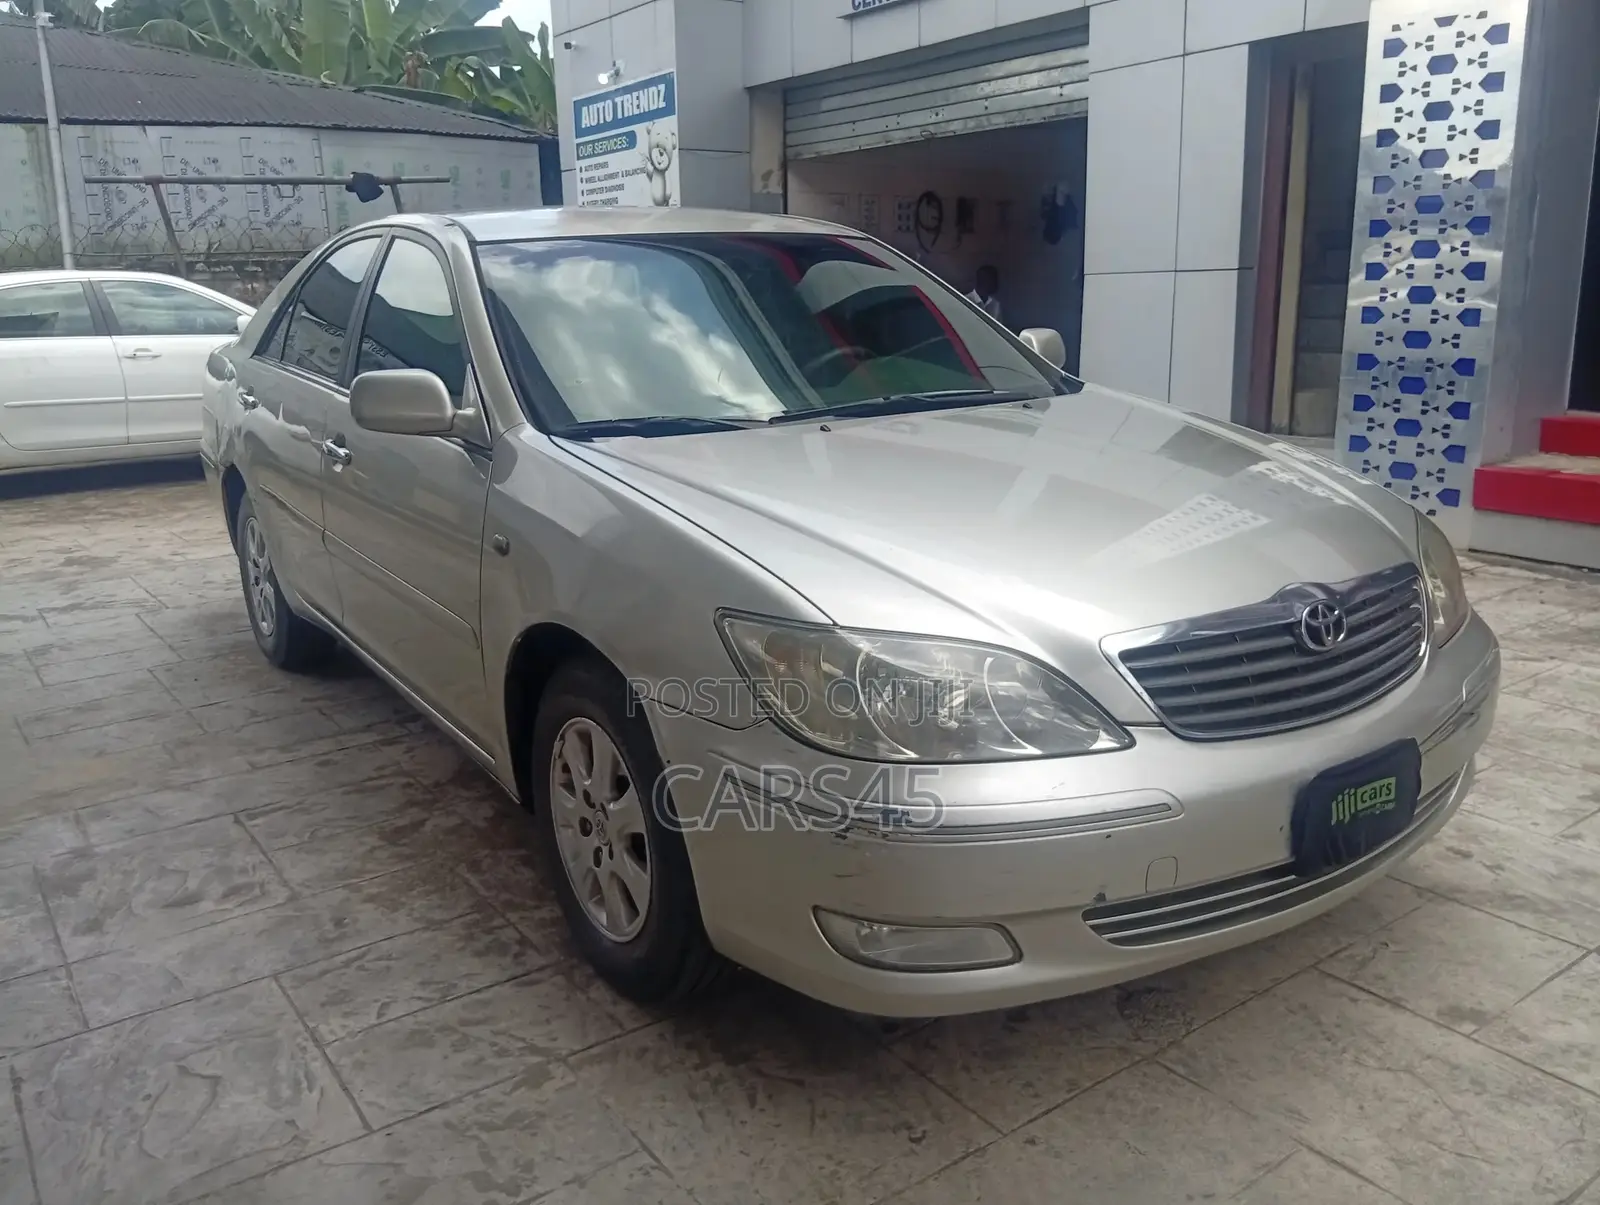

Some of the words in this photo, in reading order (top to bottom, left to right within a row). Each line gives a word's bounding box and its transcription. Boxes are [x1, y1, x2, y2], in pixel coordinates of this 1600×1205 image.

[581, 100, 613, 129] AUTO
[614, 84, 667, 120] TRENDZ
[578, 144, 593, 157] OUR
[594, 136, 630, 154] SERVICES:
[1360, 781, 1393, 804] cars
